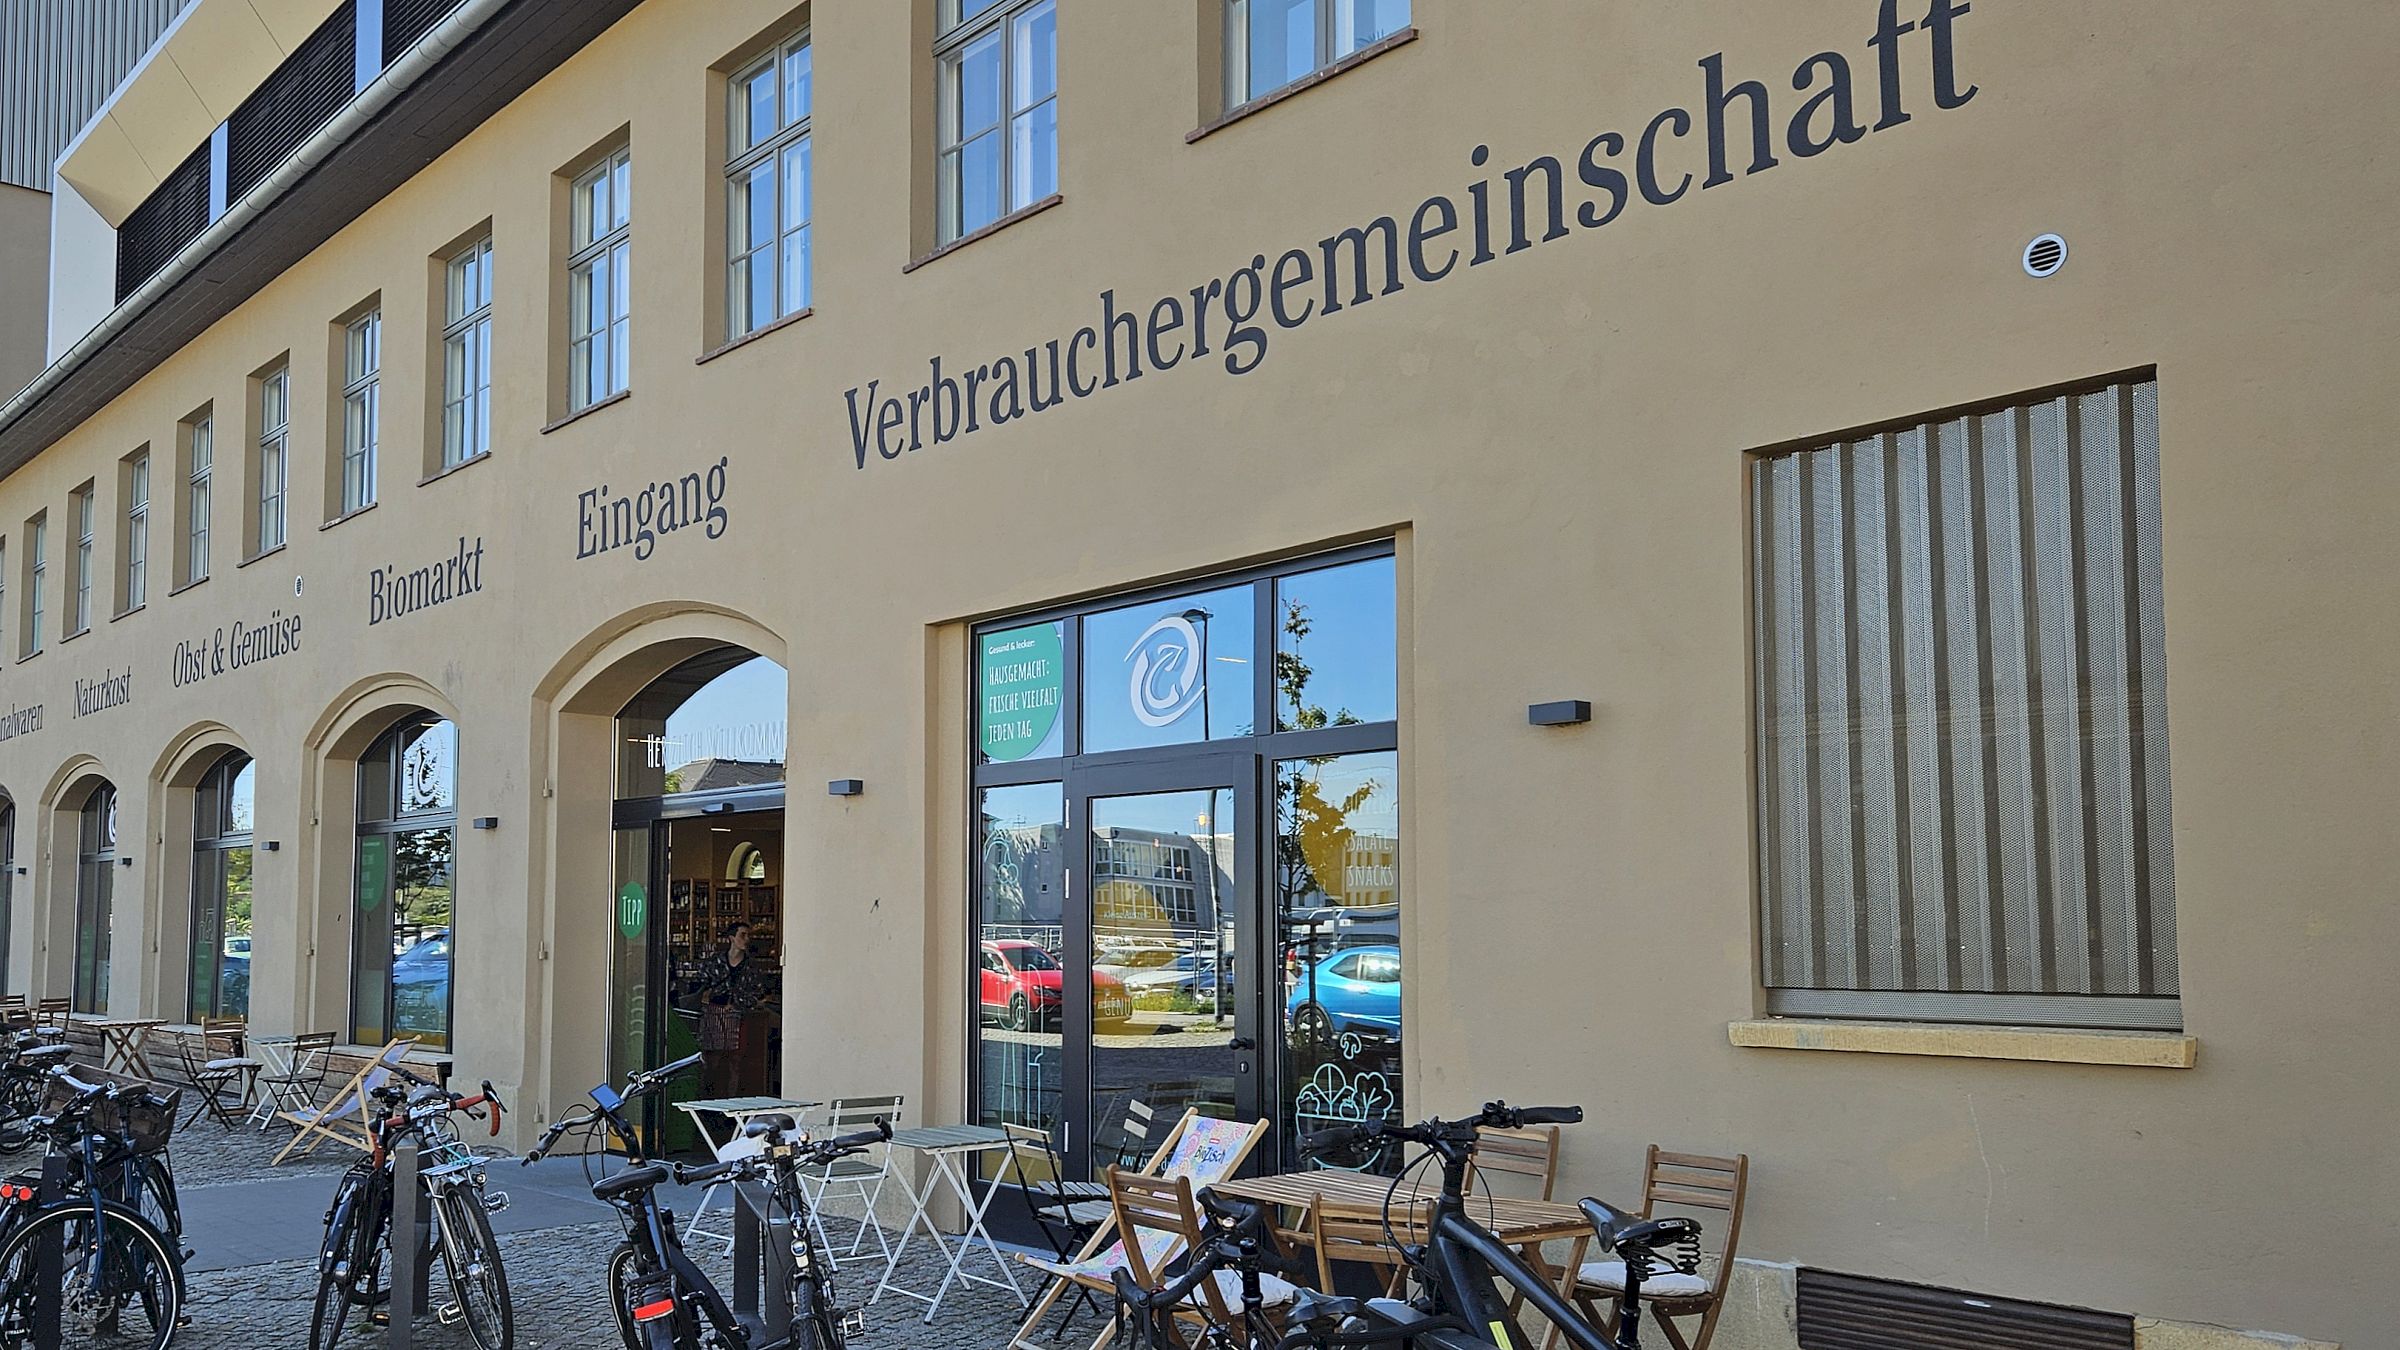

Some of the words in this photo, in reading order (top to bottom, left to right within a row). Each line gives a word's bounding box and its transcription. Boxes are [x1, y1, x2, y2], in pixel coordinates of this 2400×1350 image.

[844, 0, 1979, 469] Verbrauchergemeinschaft
[576, 456, 728, 561] Eingang
[369, 536, 484, 626] Biomarkt
[173, 638, 207, 688] Obst
[211, 627, 225, 676] &
[230, 609, 301, 670] Gemüse
[988, 643, 1010, 655] Gesund
[989, 659, 1050, 686] HAUSGEMACHT:
[73, 665, 131, 720] Naturkost
[988, 692, 1019, 715] FRISCHE
[1021, 686, 1058, 709] VIELFALT
[988, 722, 1014, 745] JEDEN
[1017, 720, 1032, 739] TAG
[1347, 865, 1394, 887] SNACKS
[622, 896, 642, 926] TIPP
